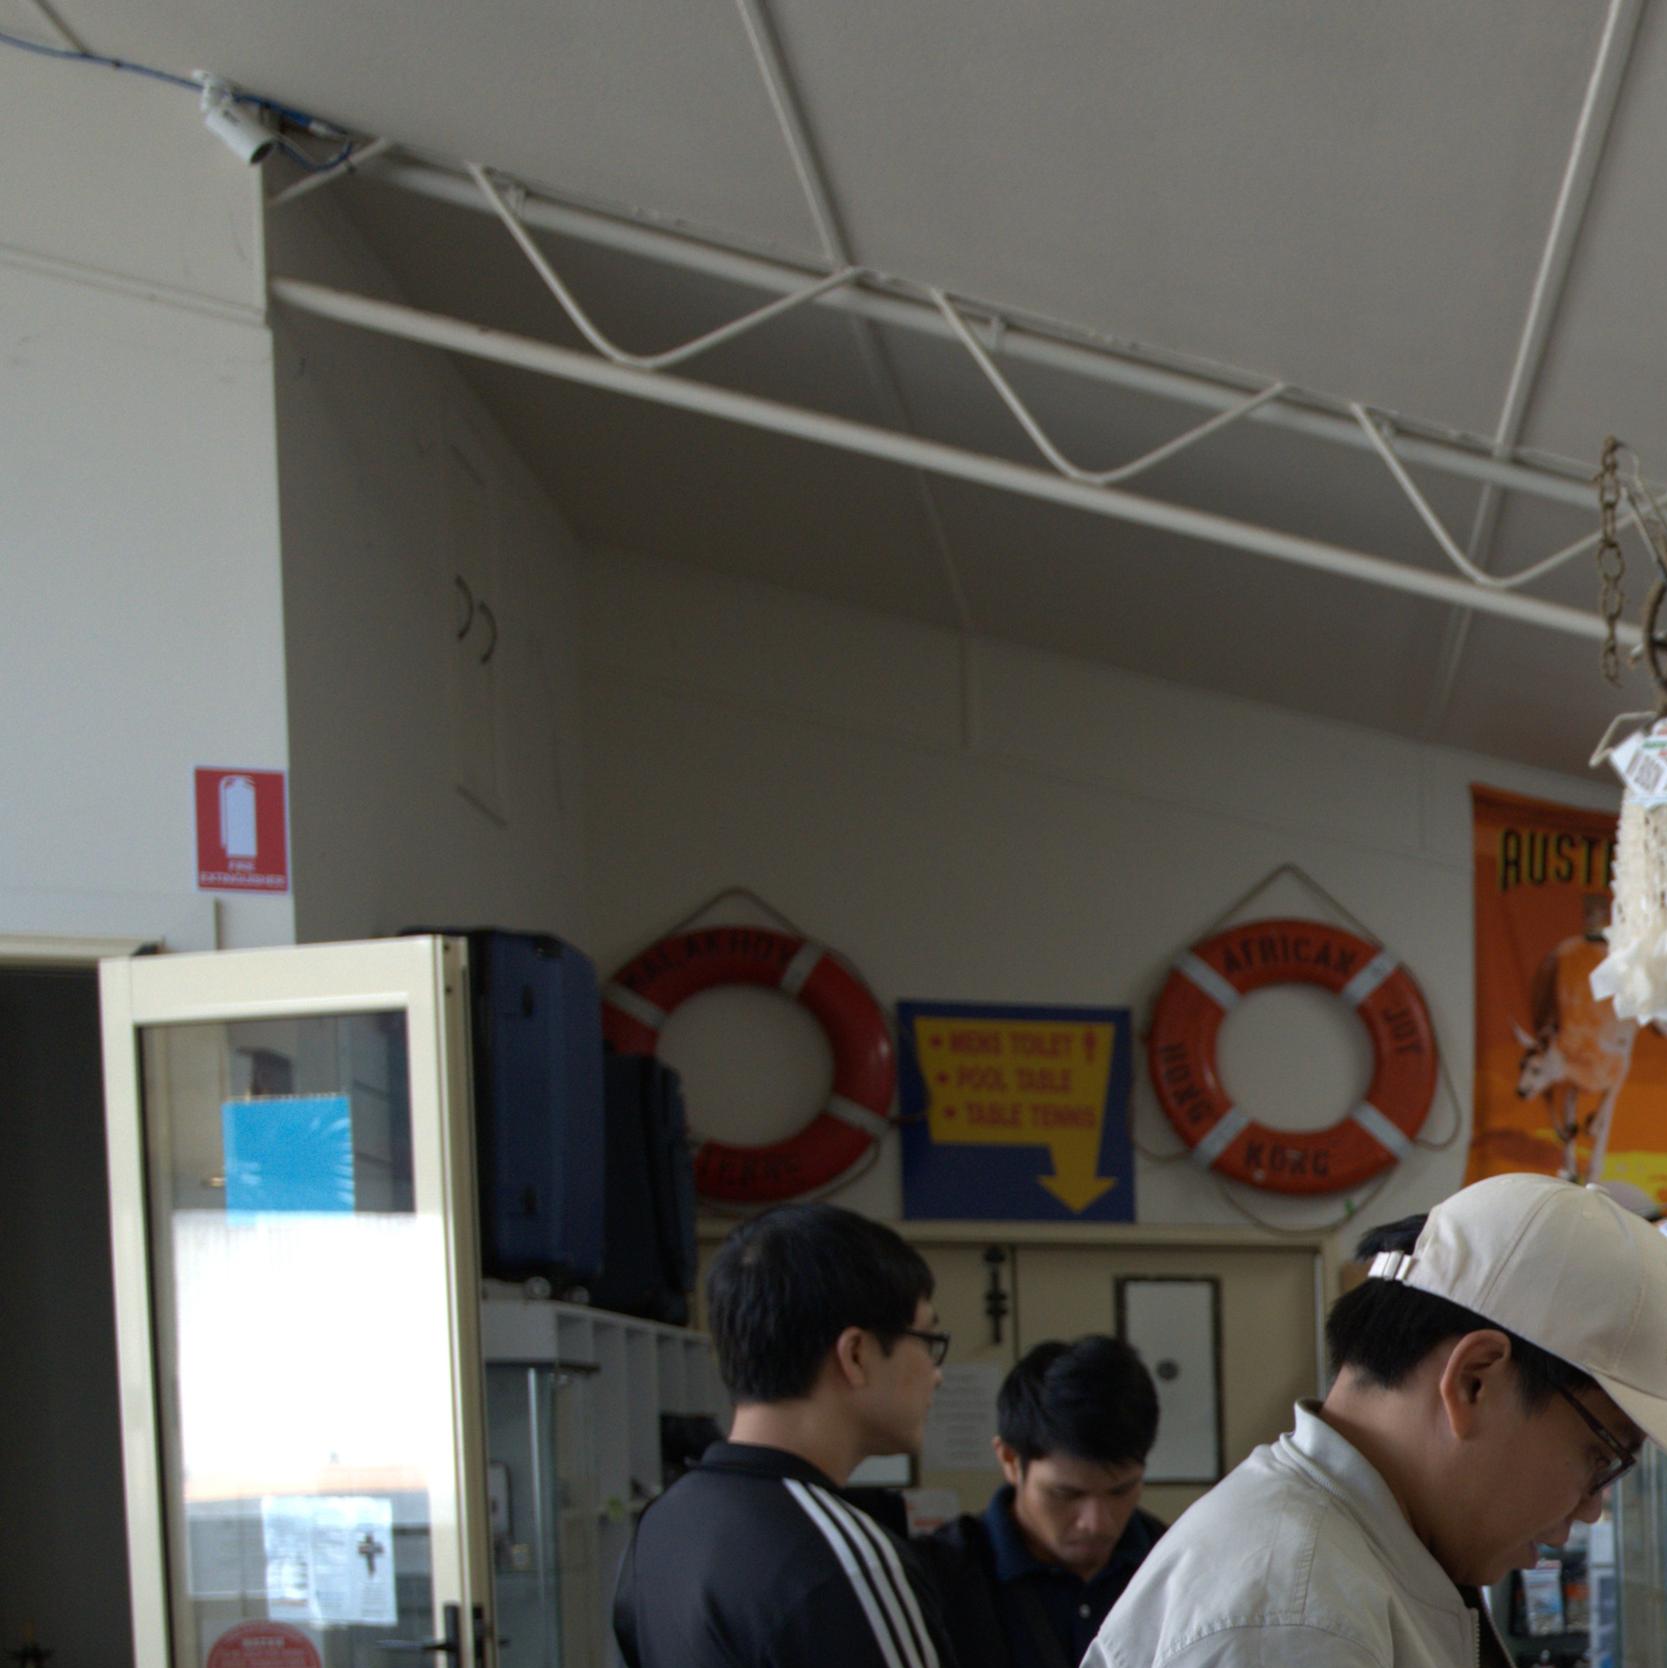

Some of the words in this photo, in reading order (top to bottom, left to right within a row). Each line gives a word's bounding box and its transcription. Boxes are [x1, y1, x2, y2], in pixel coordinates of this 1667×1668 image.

[1223, 933, 1356, 974] AFRICAN
[1383, 1007, 1423, 1055] JOY
[1162, 1041, 1215, 1126] HONG
[1244, 1143, 1330, 1178] KONG
